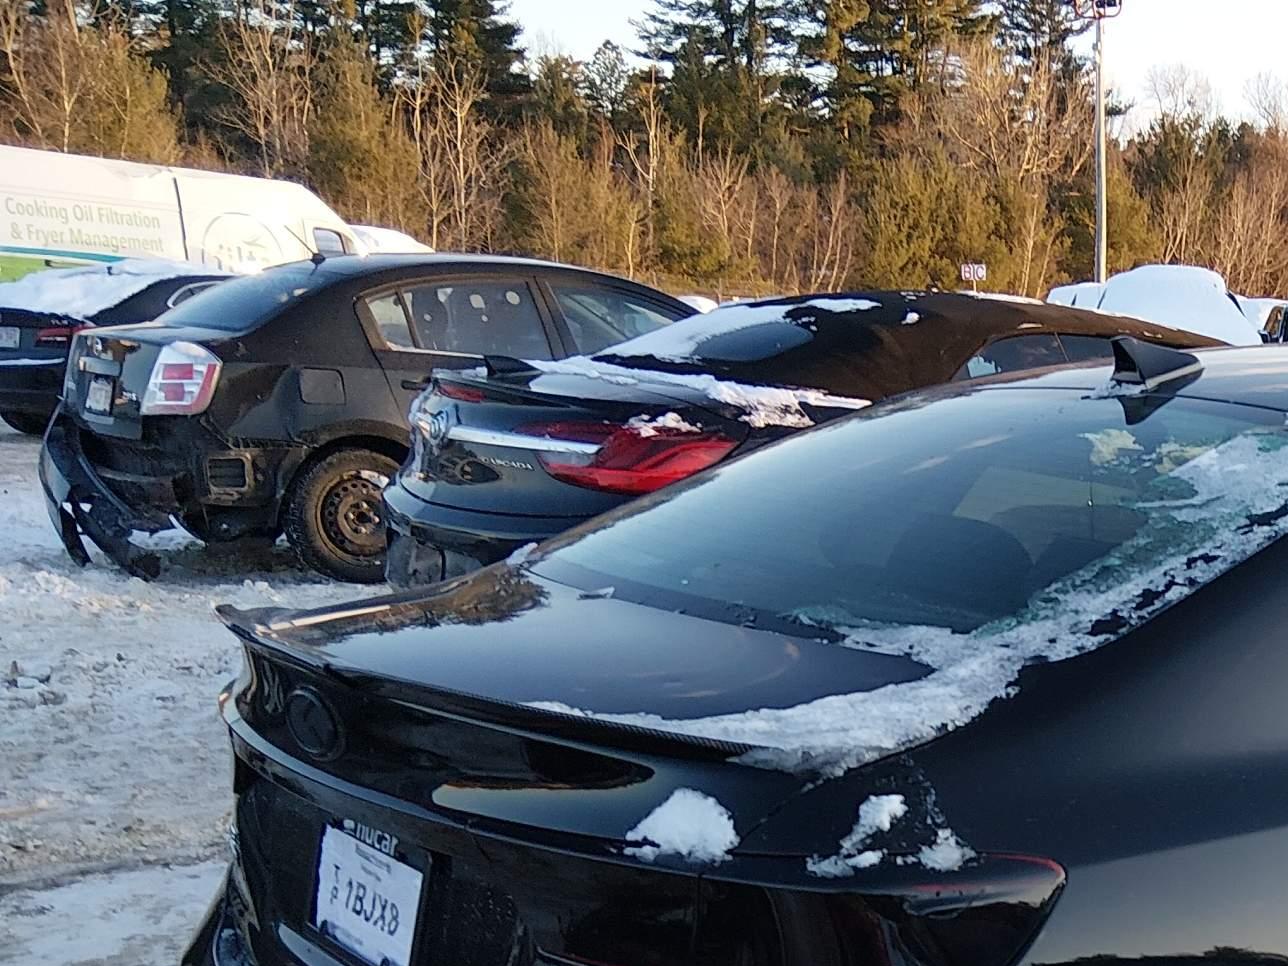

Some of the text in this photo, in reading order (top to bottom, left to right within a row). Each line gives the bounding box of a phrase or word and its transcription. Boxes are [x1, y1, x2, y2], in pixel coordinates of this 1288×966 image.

[5, 197, 161, 229] Cooking Oil Filtration
[10, 222, 164, 253] & Fryer Management
[963, 264, 972, 279] B
[976, 265, 985, 279] C
[356, 822, 399, 857] nucar
[345, 876, 400, 937] 1BJX8
